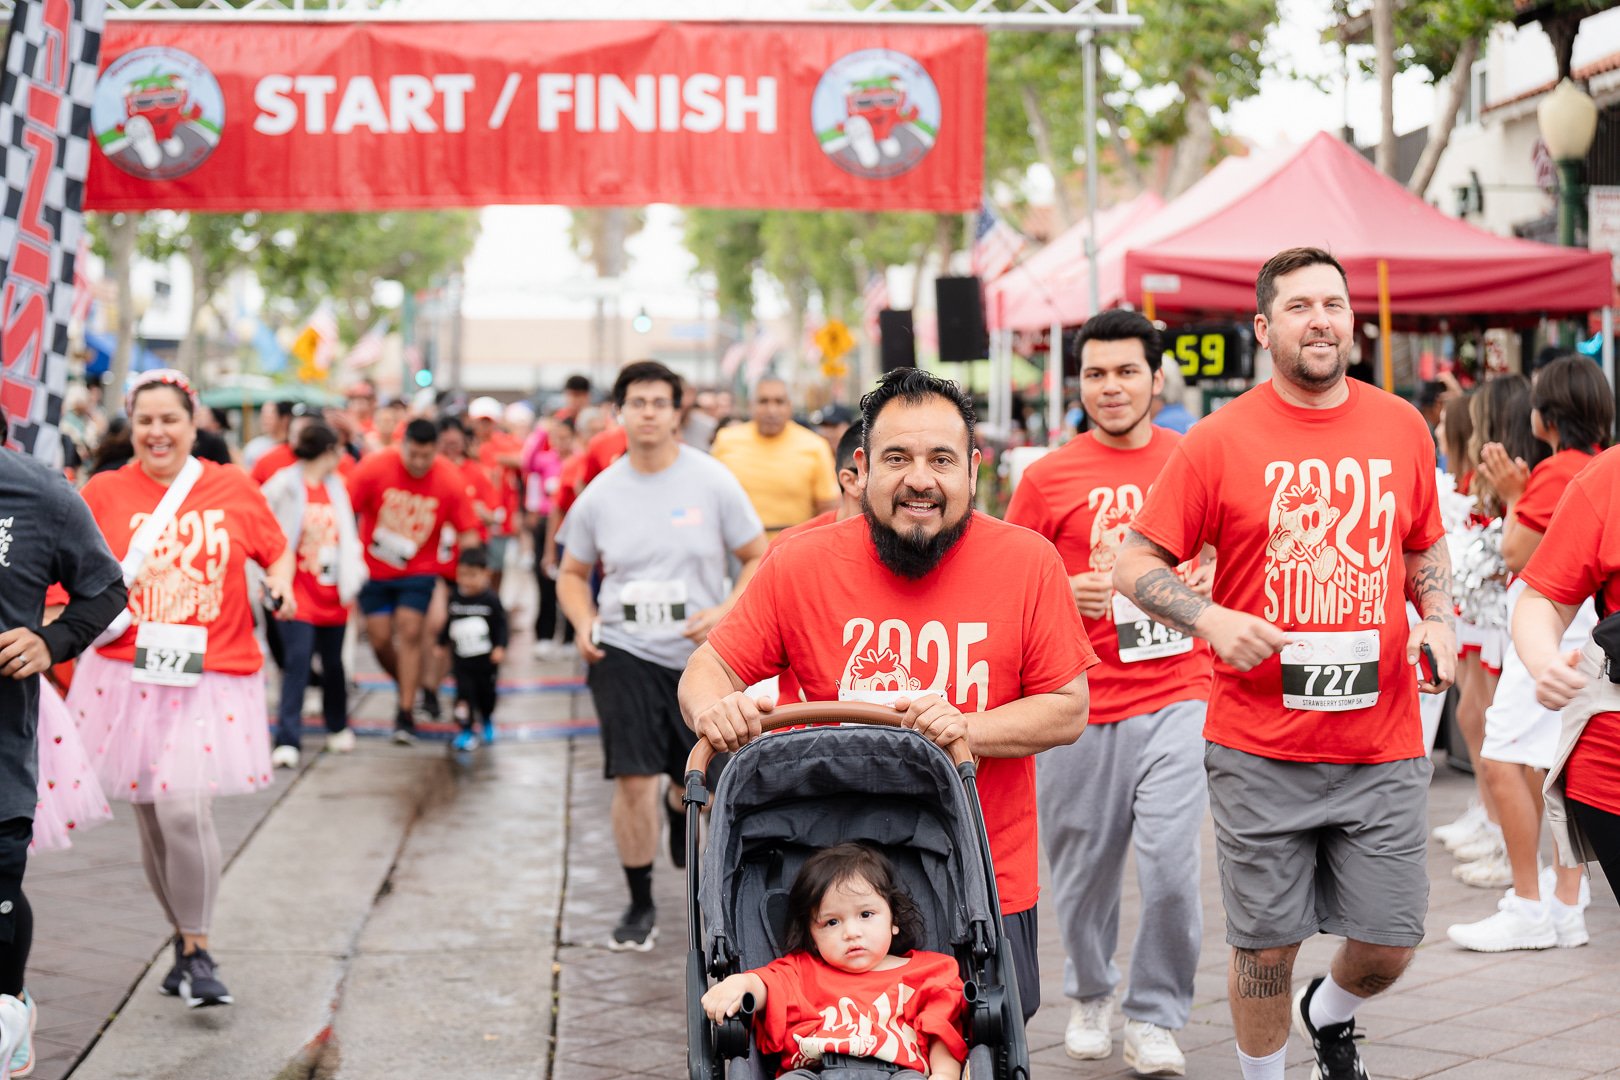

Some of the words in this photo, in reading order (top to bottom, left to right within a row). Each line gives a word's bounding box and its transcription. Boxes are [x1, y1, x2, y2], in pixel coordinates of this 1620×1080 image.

[254, 74, 475, 135] START
[488, 73, 521, 130] /
[538, 73, 777, 133] FINISH
[1264, 457, 1396, 569] 2025
[1264, 564, 1354, 625] STOMP
[1358, 584, 1388, 625] 5K
[145, 648, 191, 673] 527
[1303, 664, 1361, 696] 727
[1302, 699, 1337, 707] STRAWBERRY
[1338, 698, 1355, 707] STOMP
[1356, 697, 1363, 705] 5K
